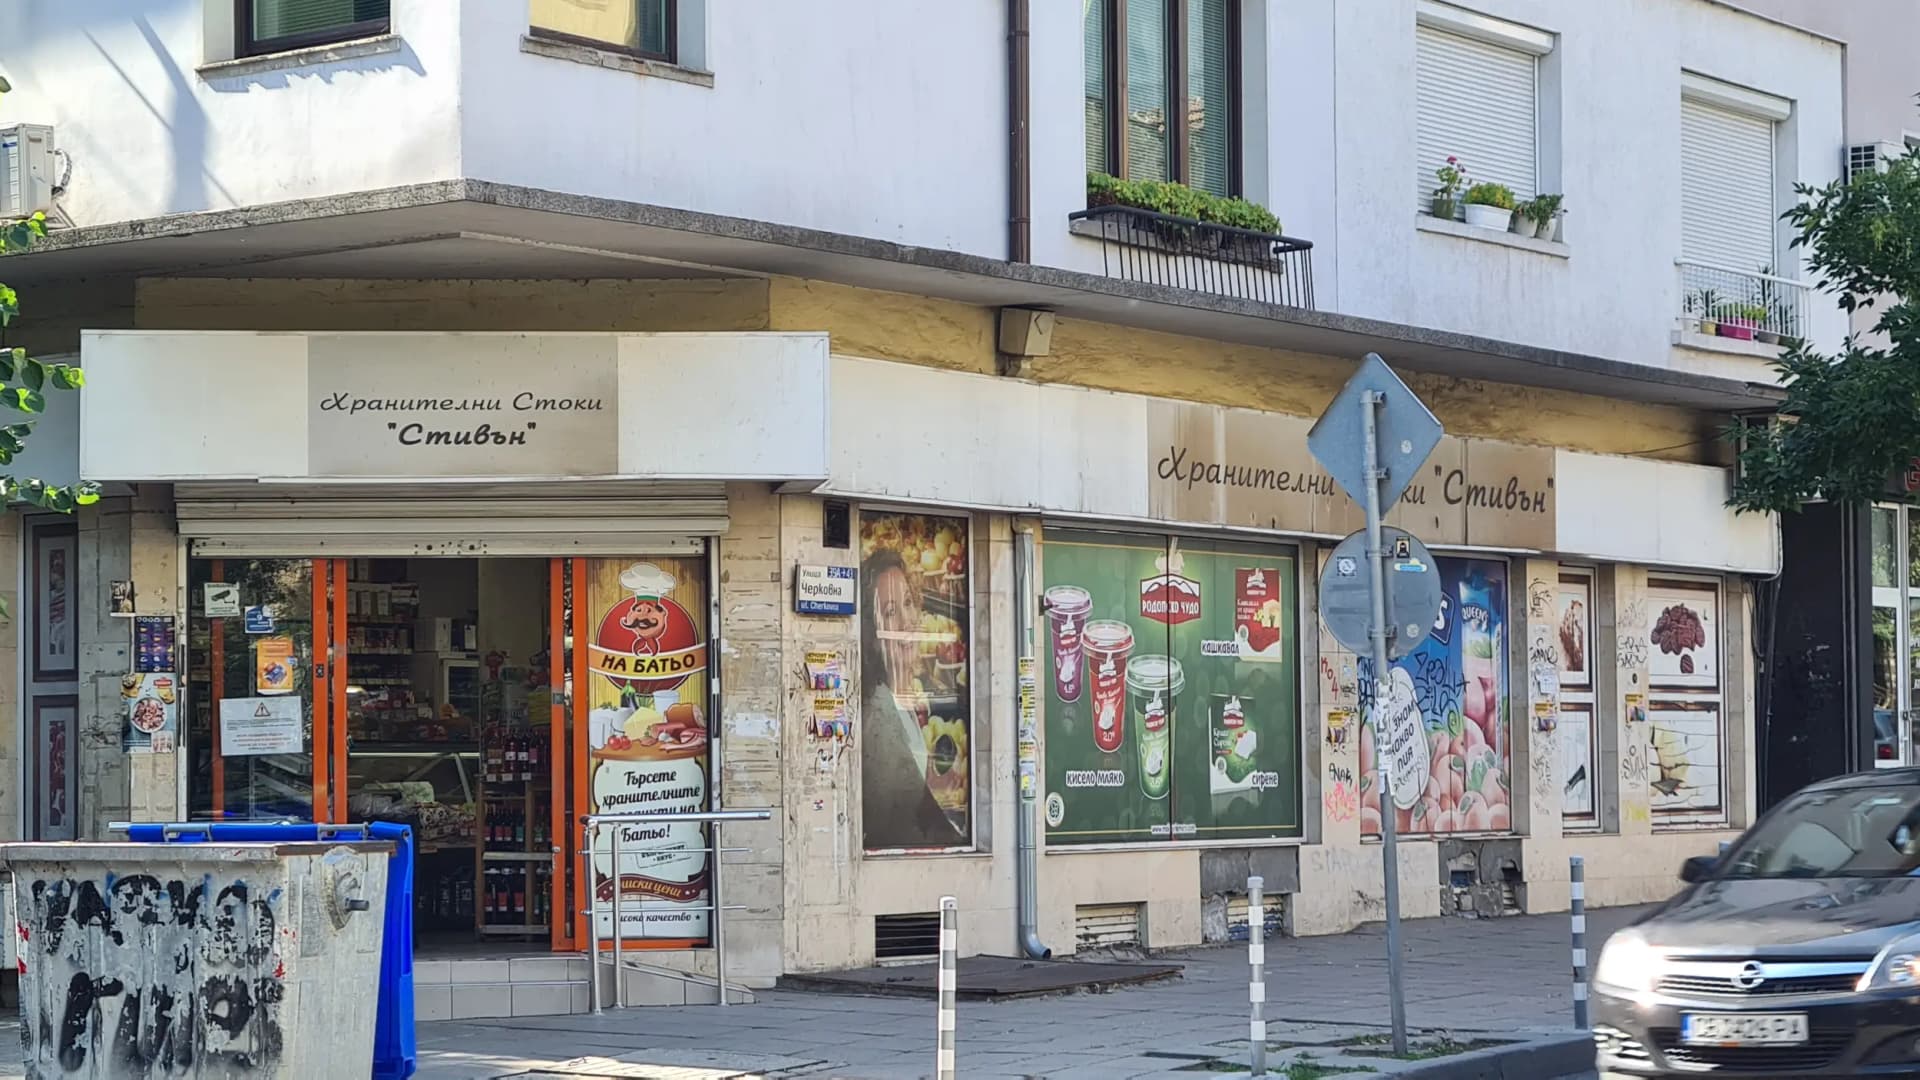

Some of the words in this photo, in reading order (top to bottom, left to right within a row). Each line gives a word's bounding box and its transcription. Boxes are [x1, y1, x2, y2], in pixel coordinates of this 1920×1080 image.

[320, 392, 502, 415] Хранителни
[512, 391, 603, 411] Стоки
[387, 422, 537, 446] "Стивън"
[1157, 446, 1336, 496] Хранителни
[1434, 465, 1554, 512] "Стивън"
[802, 568, 821, 578] Улица
[801, 582, 842, 596] Черковна
[1180, 601, 1200, 614] ЧУДО
[601, 654, 627, 672] НА
[633, 653, 696, 673] БАТЬО
[624, 771, 677, 788] Търсете
[602, 786, 701, 810] хранителните
[621, 824, 671, 842] Батьо!
[617, 879, 653, 890] иски
[615, 913, 644, 922] исоко
[645, 912, 692, 922] качество
